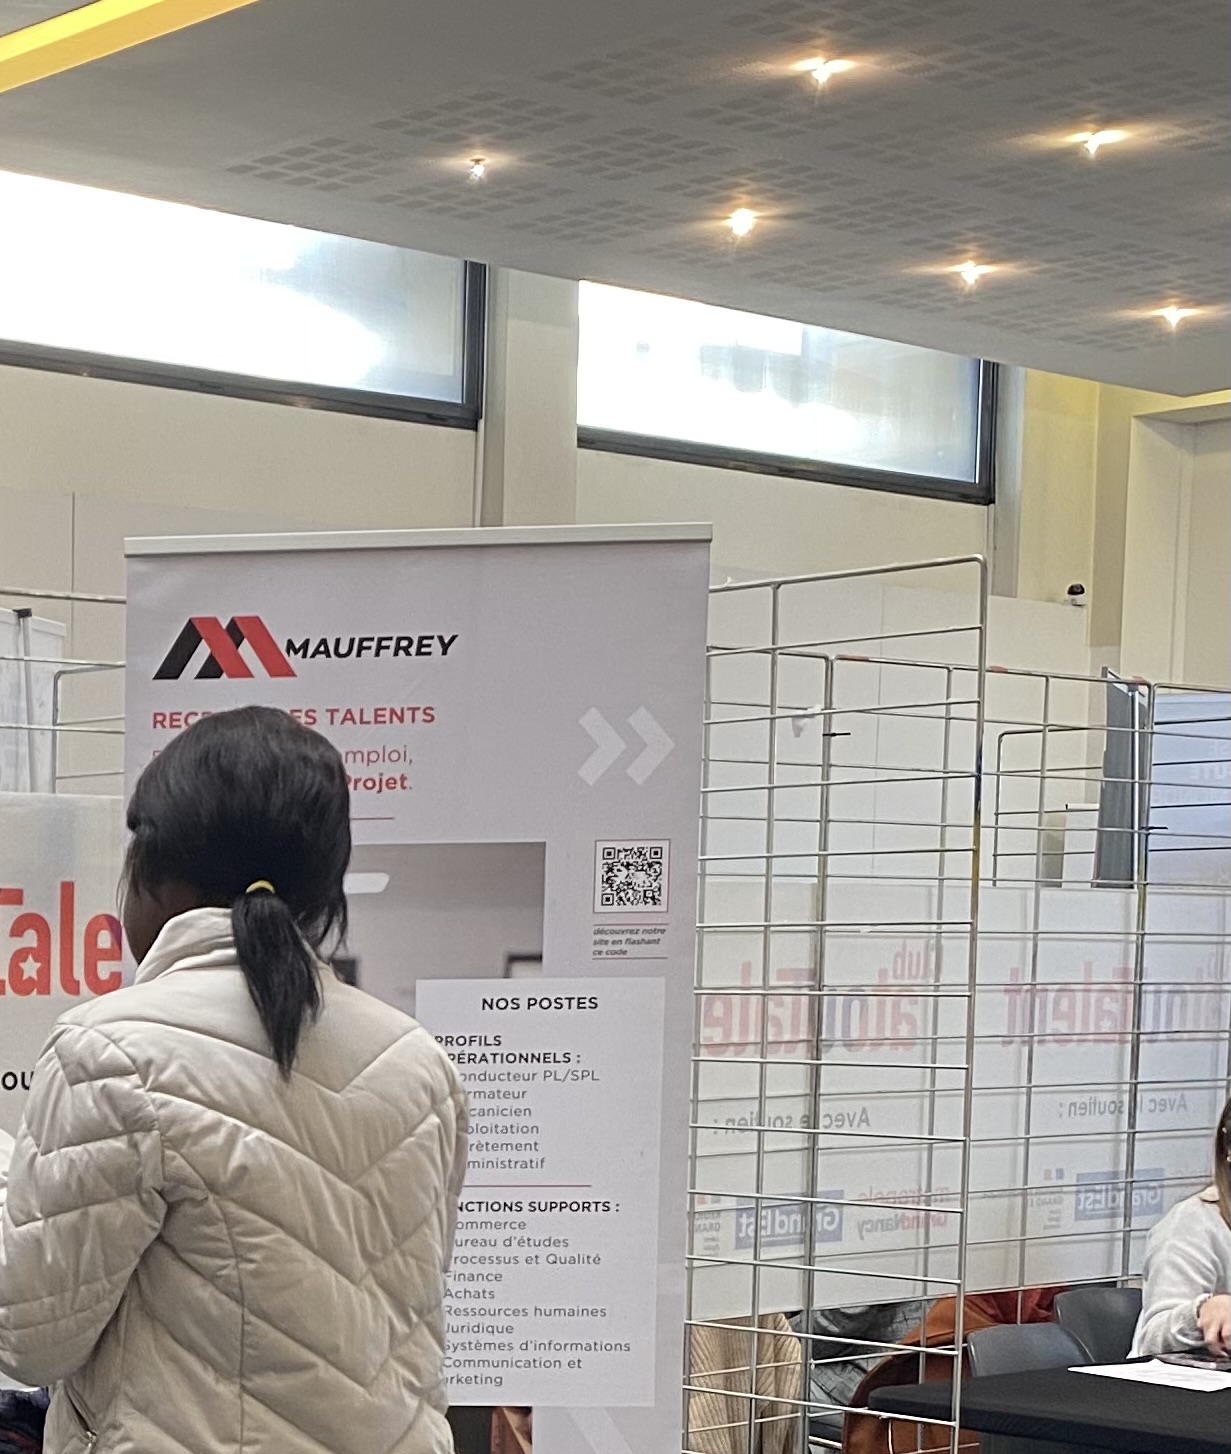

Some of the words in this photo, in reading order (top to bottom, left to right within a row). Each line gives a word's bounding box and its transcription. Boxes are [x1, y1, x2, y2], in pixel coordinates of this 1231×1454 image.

[286, 634, 459, 660] MAUFFREY
[325, 706, 436, 726] TALENTS
[344, 744, 414, 767] mploi,
[481, 998, 521, 1011] NOS
[526, 996, 599, 1010] POSTES
[447, 1050, 571, 1064] PÉRATIONNELS
[459, 1069, 538, 1082] onducteur
[543, 1069, 600, 1083] PL/SPL
[469, 1105, 532, 1117] canicien
[469, 1140, 539, 1152] rètement
[467, 1157, 545, 1169] ministratif
[528, 1201, 610, 1213] SUPPORTS
[456, 1221, 527, 1230] ommerce
[455, 1238, 497, 1247] ureau
[503, 1236, 569, 1248] d'études
[454, 1256, 519, 1265] rocessus
[525, 1255, 539, 1265] et
[546, 1253, 601, 1266] Qualité
[443, 1288, 495, 1299] Achats
[445, 1305, 528, 1317] Ressources
[534, 1305, 607, 1317] humaines
[446, 1322, 514, 1336] Juridique
[519, 1339, 630, 1352] d'informations
[443, 1357, 561, 1368] Communication
[568, 1358, 582, 1368] et
[446, 1373, 503, 1387] rketing
